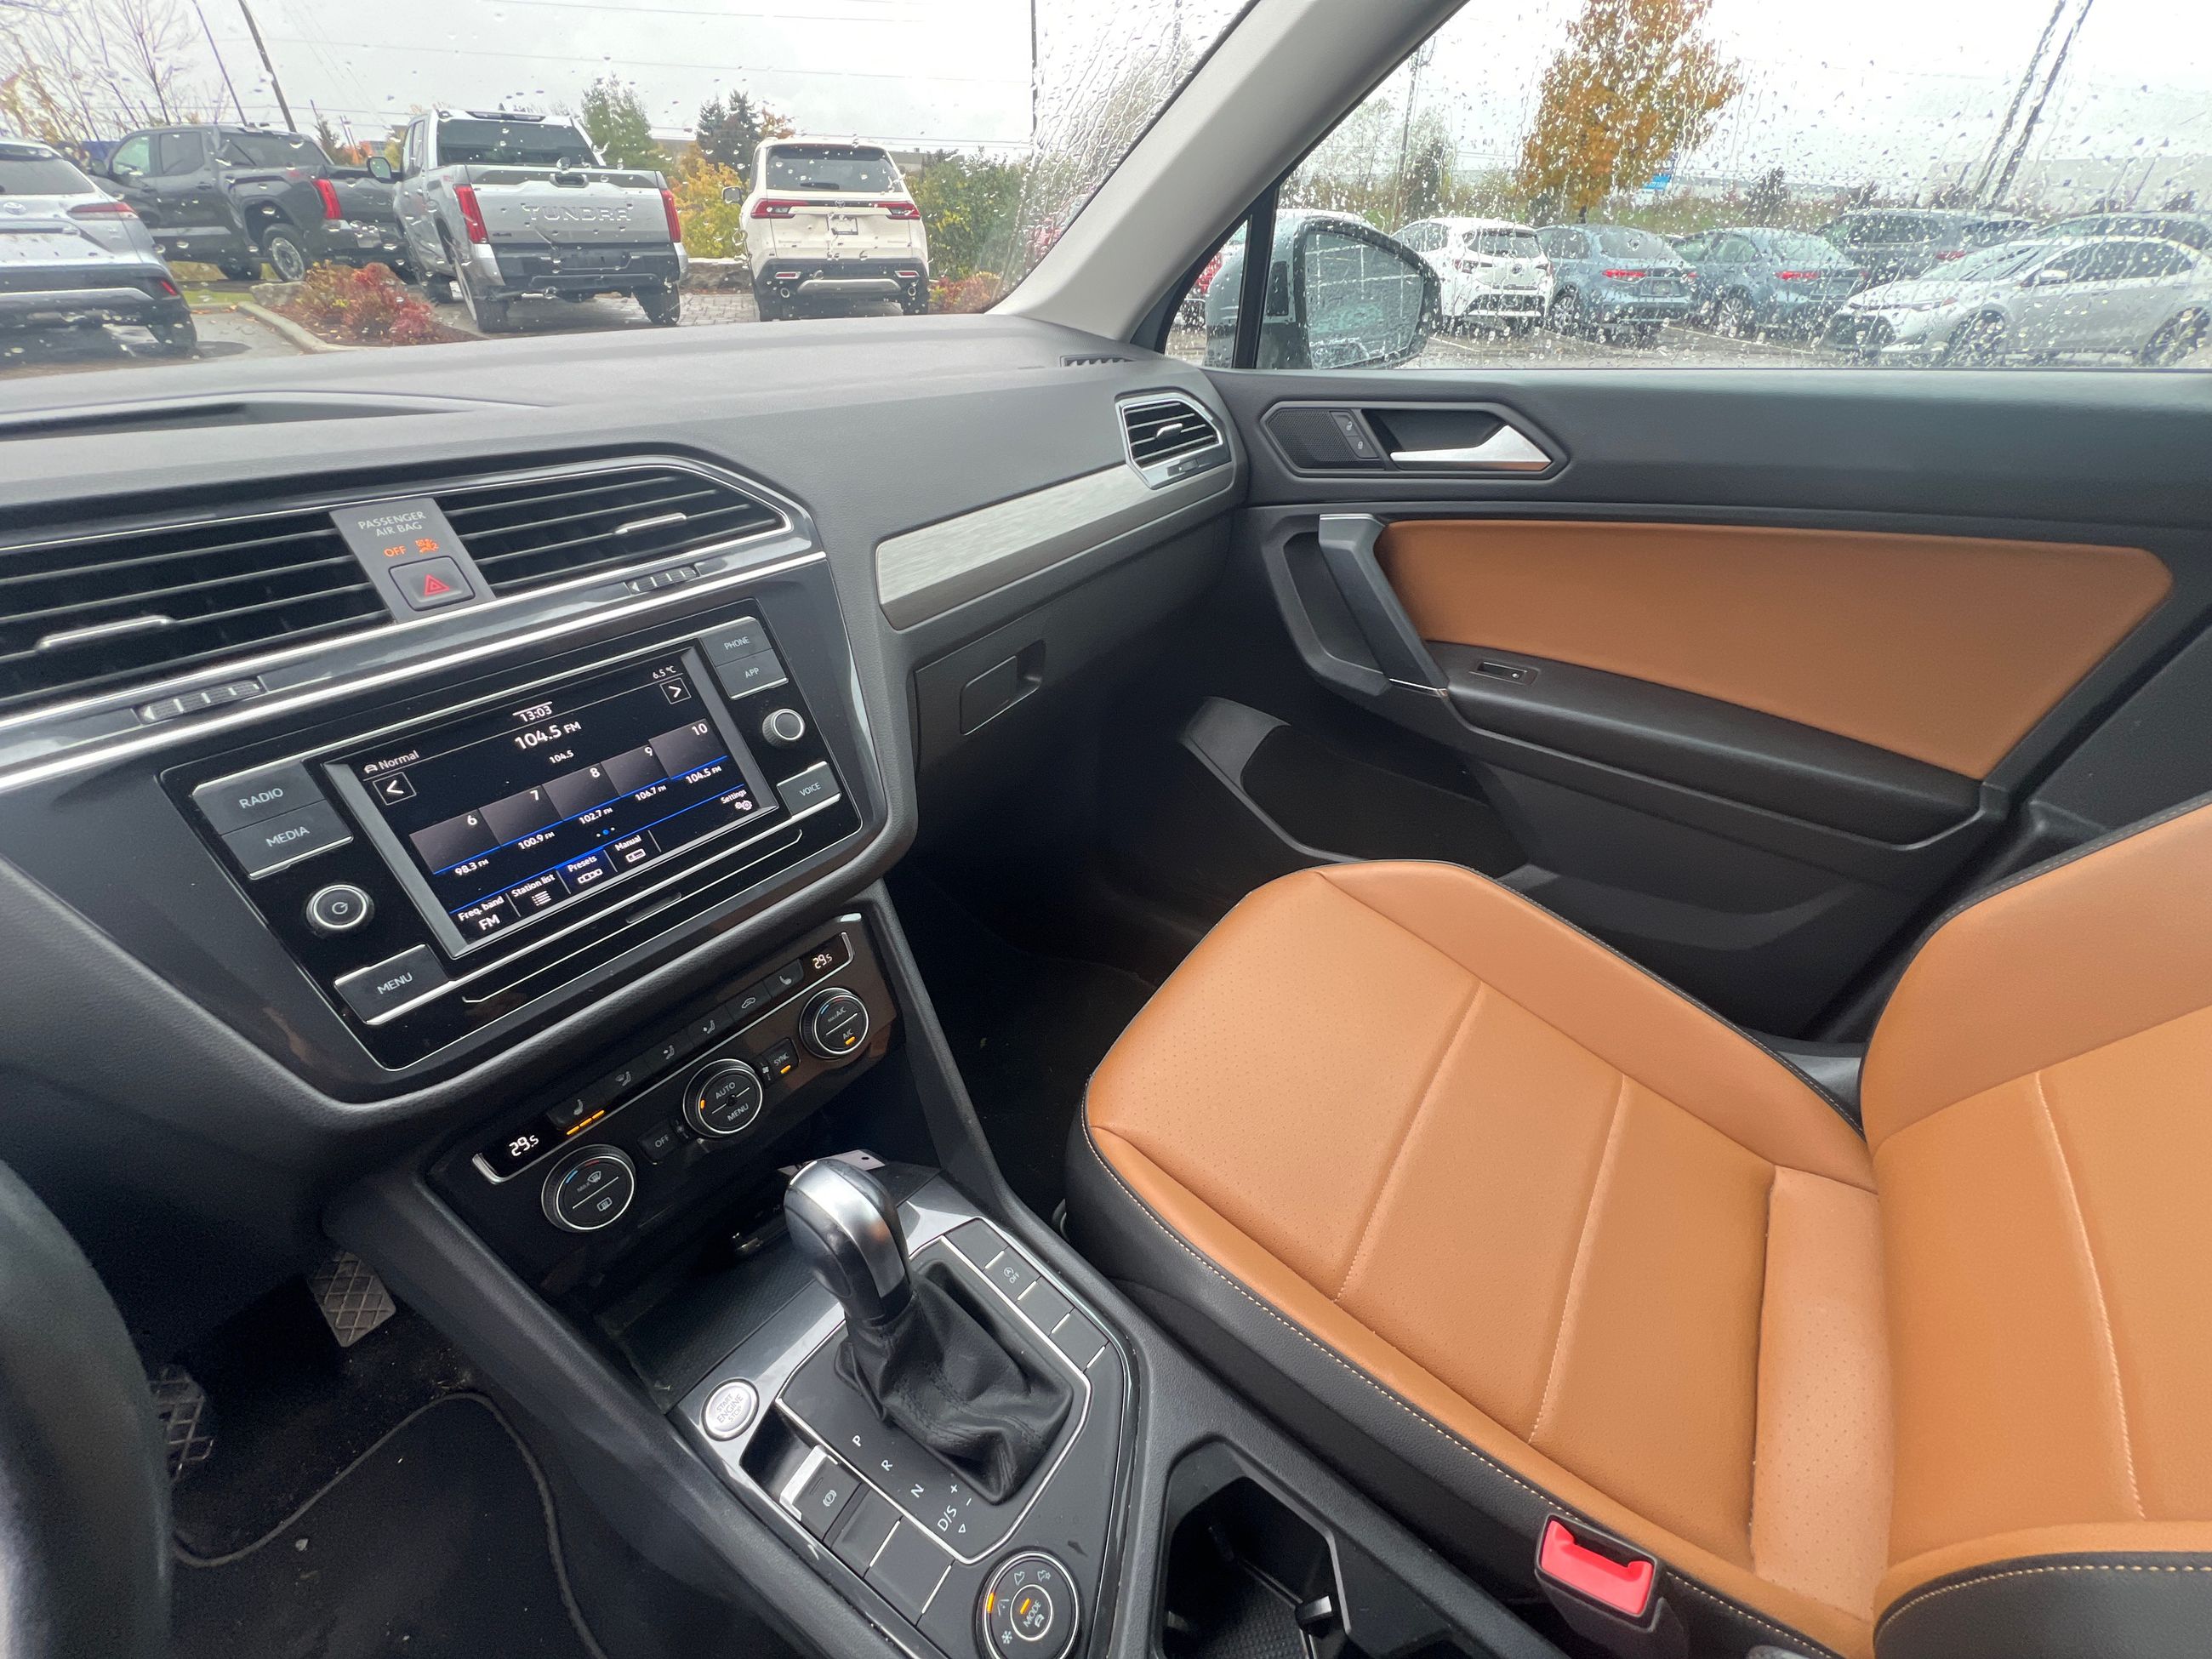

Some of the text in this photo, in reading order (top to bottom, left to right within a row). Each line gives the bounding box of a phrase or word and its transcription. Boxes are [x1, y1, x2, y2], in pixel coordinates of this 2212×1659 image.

[522, 205, 631, 221] TUNDRA
[357, 511, 426, 530] PASSENGER
[375, 522, 422, 538] AIR BAG
[384, 545, 407, 557] OFF
[724, 636, 750, 650] PHONE
[653, 669, 666, 680] 6.5
[744, 667, 760, 679] APP
[520, 705, 552, 721] 13:03
[514, 721, 581, 750] 104.5 FM
[691, 722, 709, 737] 10
[549, 749, 574, 764] 104.5
[644, 746, 653, 757] 9
[378, 750, 419, 771] Normal
[590, 767, 601, 778] 8
[686, 768, 711, 785] 104.5
[530, 790, 539, 801] 7
[635, 788, 658, 802] 106.7
[720, 788, 747, 805] Settings
[800, 782, 821, 796] VOICE
[239, 788, 284, 809] RADIO
[467, 814, 477, 827] 6
[579, 807, 613, 825] 102.7 FM
[265, 825, 310, 848] MEDIA
[517, 830, 556, 851] 100.9 FM
[614, 834, 642, 852] Manual
[454, 858, 490, 876] 98.3 FM
[567, 855, 598, 873] Presets
[511, 873, 556, 898] Station list
[483, 895, 505, 910] band
[477, 913, 500, 932] FM
[377, 972, 413, 995] MENU
[773, 1052, 790, 1066] SYNC
[714, 1081, 737, 1100] AUTO
[727, 1103, 750, 1122] MENU
[509, 1134, 539, 1157] 29.5
[654, 1134, 670, 1149] OFF
[716, 1393, 733, 1412] START
[716, 1394, 744, 1423] ENGINE
[728, 1405, 742, 1422] STOP
[852, 1434, 863, 1448] P
[881, 1458, 893, 1472] R
[910, 1483, 926, 1498] N
[937, 1504, 958, 1533] D/S
[1023, 1600, 1041, 1628] MODE
